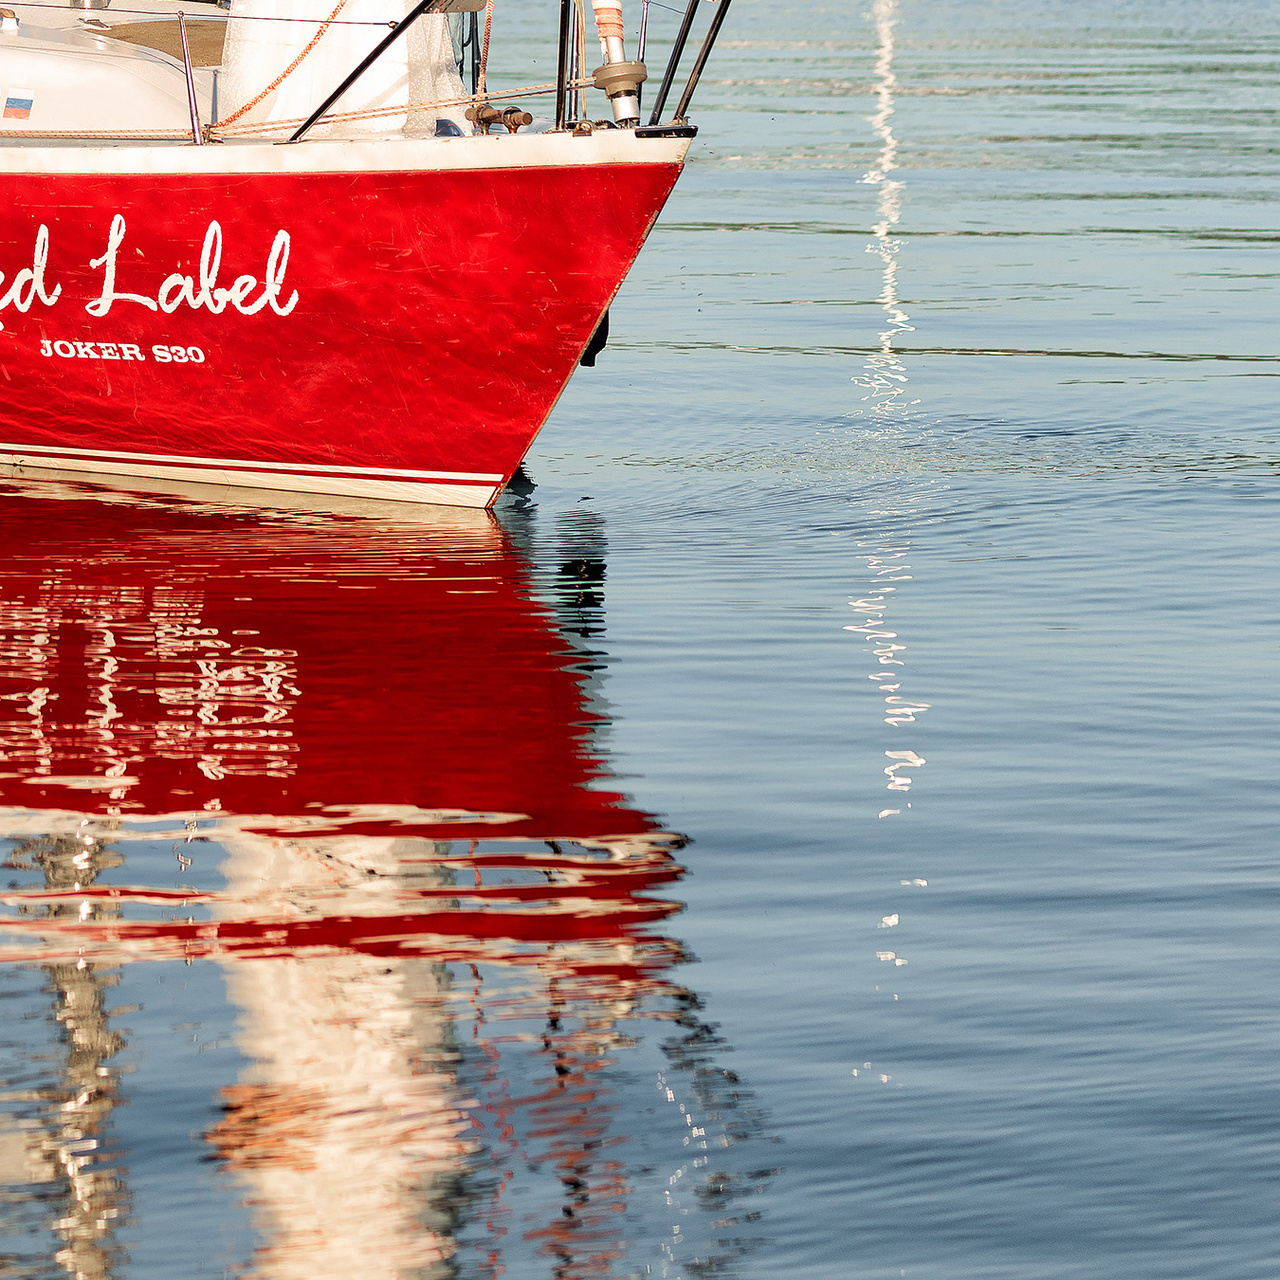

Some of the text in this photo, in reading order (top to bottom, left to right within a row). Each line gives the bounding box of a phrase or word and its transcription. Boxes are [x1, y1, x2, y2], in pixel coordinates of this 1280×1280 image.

[85, 213, 299, 317] Label
[40, 340, 206, 364] JOKER S30
